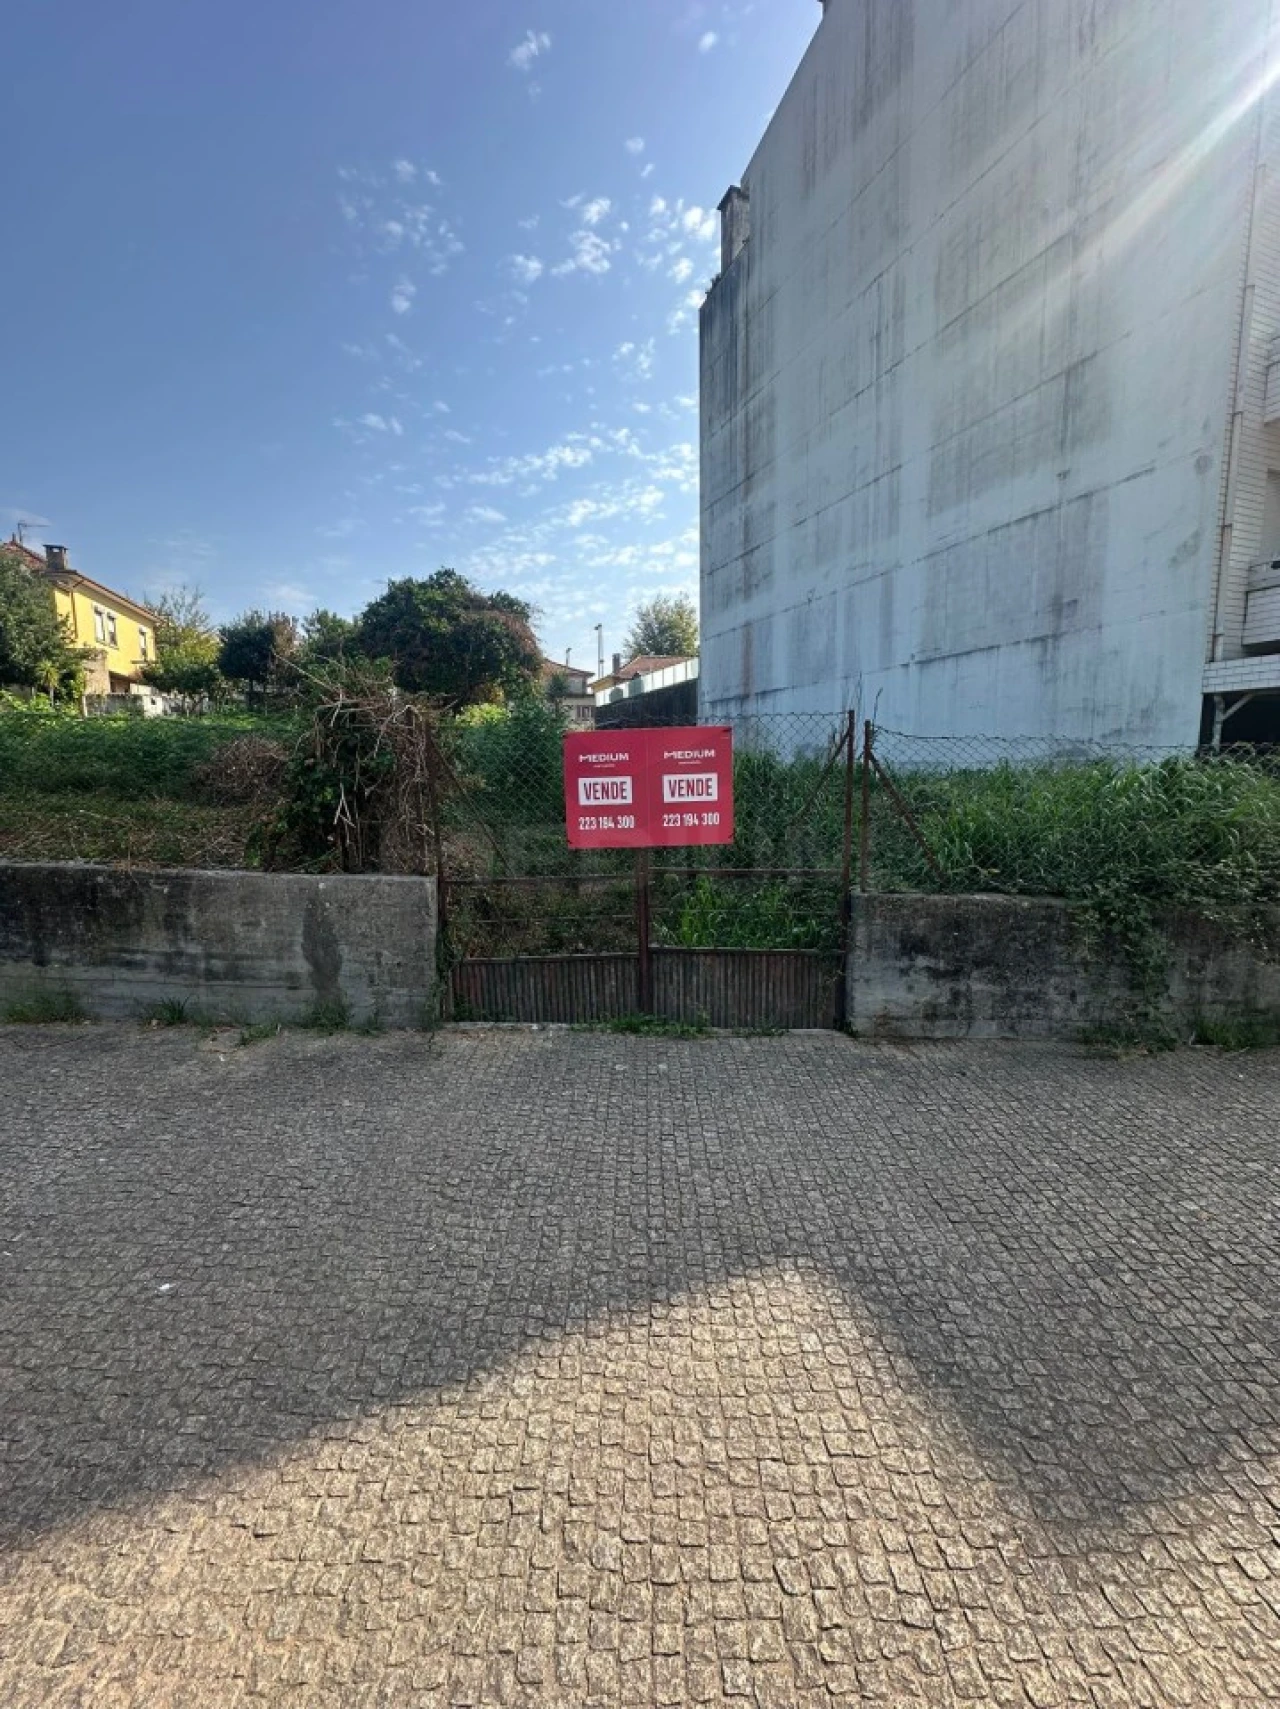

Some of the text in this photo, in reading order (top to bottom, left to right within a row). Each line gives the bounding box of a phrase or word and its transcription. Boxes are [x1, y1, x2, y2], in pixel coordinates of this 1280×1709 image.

[579, 752, 629, 763] MEDIUM
[663, 749, 715, 760] MEDIUM
[583, 782, 628, 800] VENDE
[668, 778, 713, 798] VENDE
[579, 816, 597, 831] 223
[617, 814, 635, 829] 300
[663, 811, 720, 827] 223 194 300
